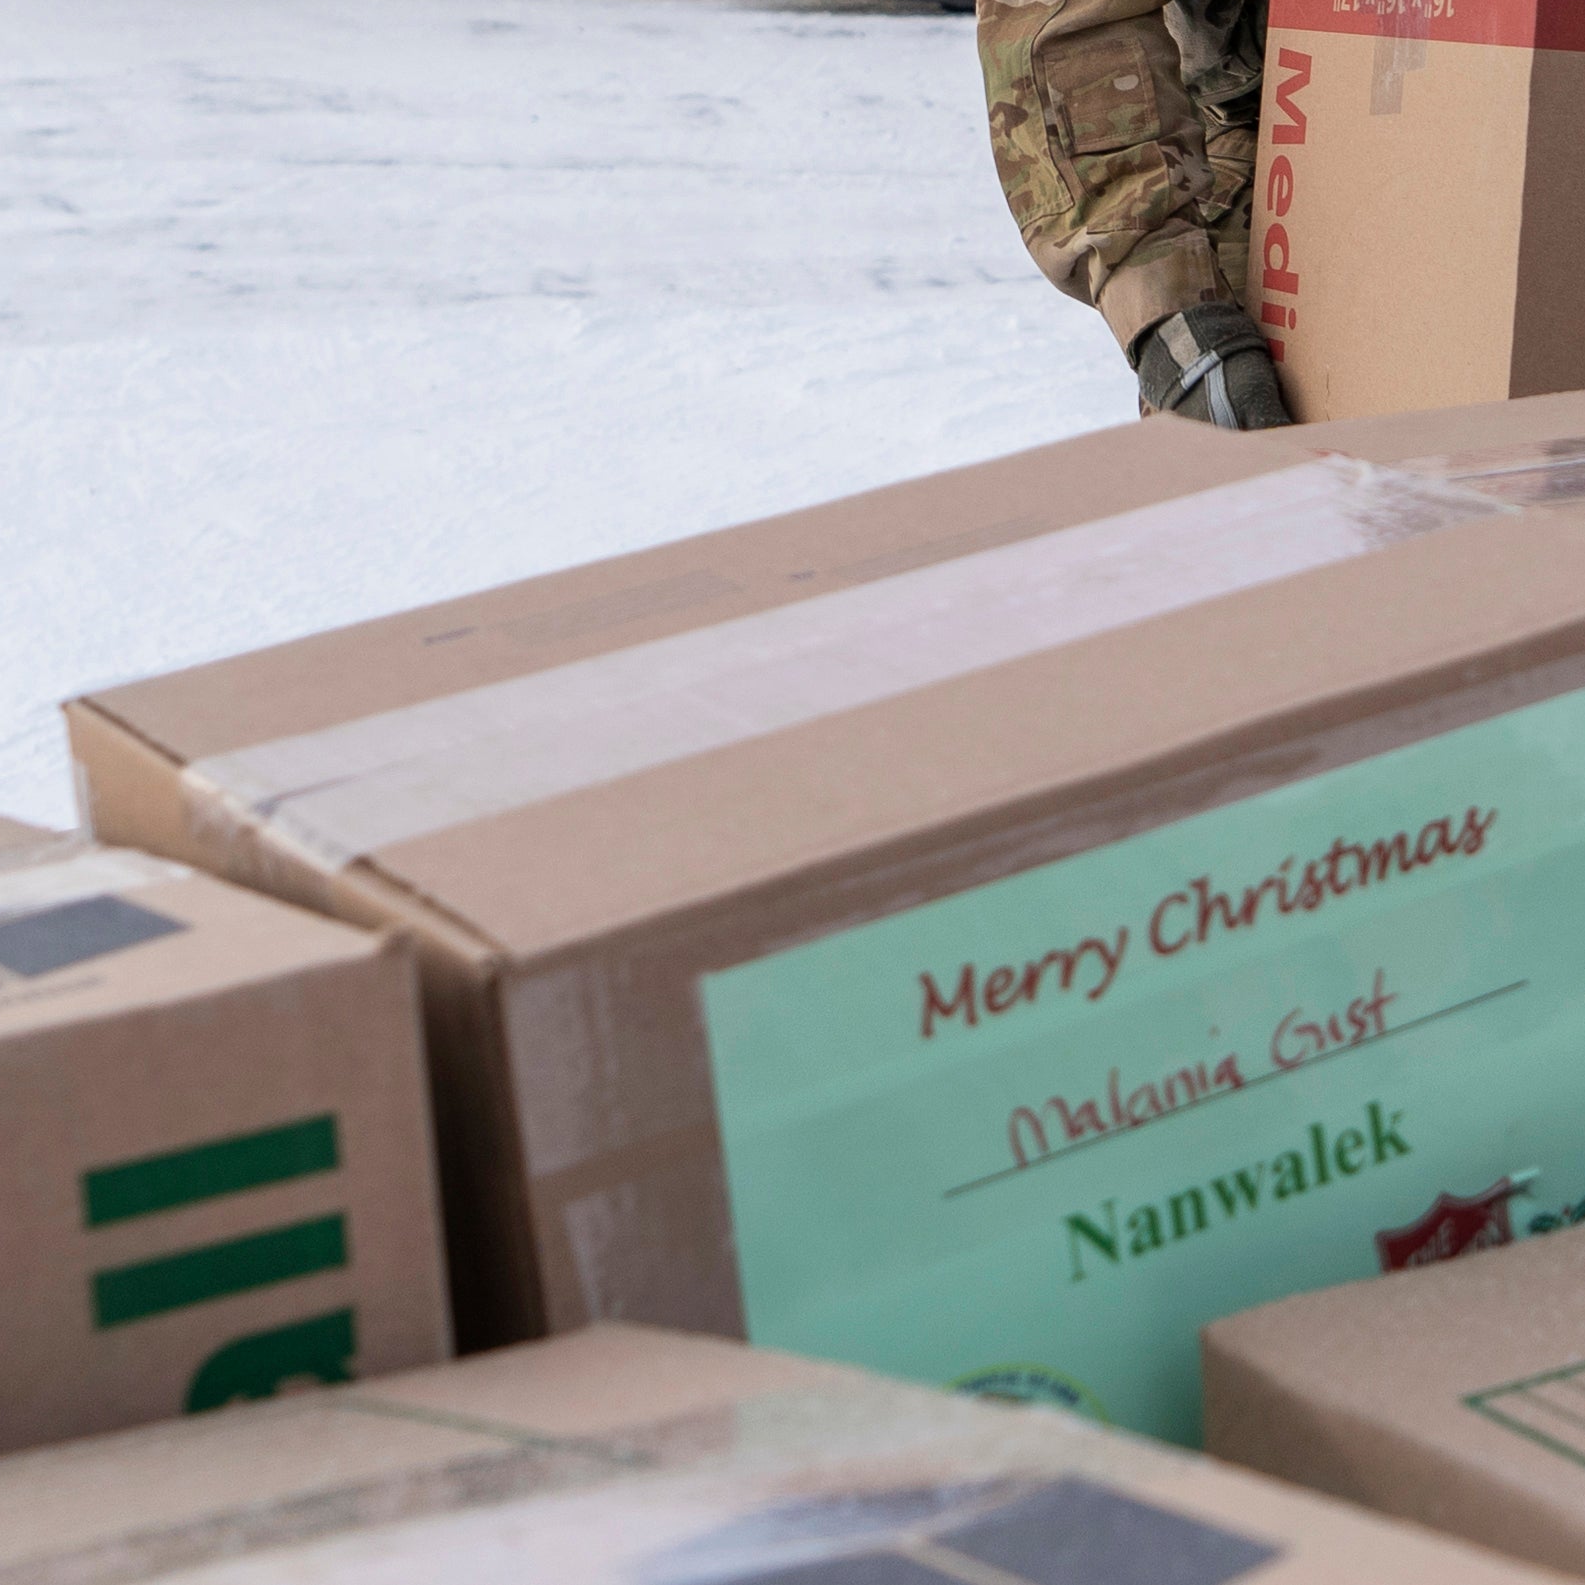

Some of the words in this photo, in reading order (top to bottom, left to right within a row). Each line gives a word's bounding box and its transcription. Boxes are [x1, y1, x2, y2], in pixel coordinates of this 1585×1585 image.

[918, 924, 1130, 1039] Merry
[1148, 803, 1499, 957] Christmas
[1061, 1098, 1412, 1282] Nanwalek
